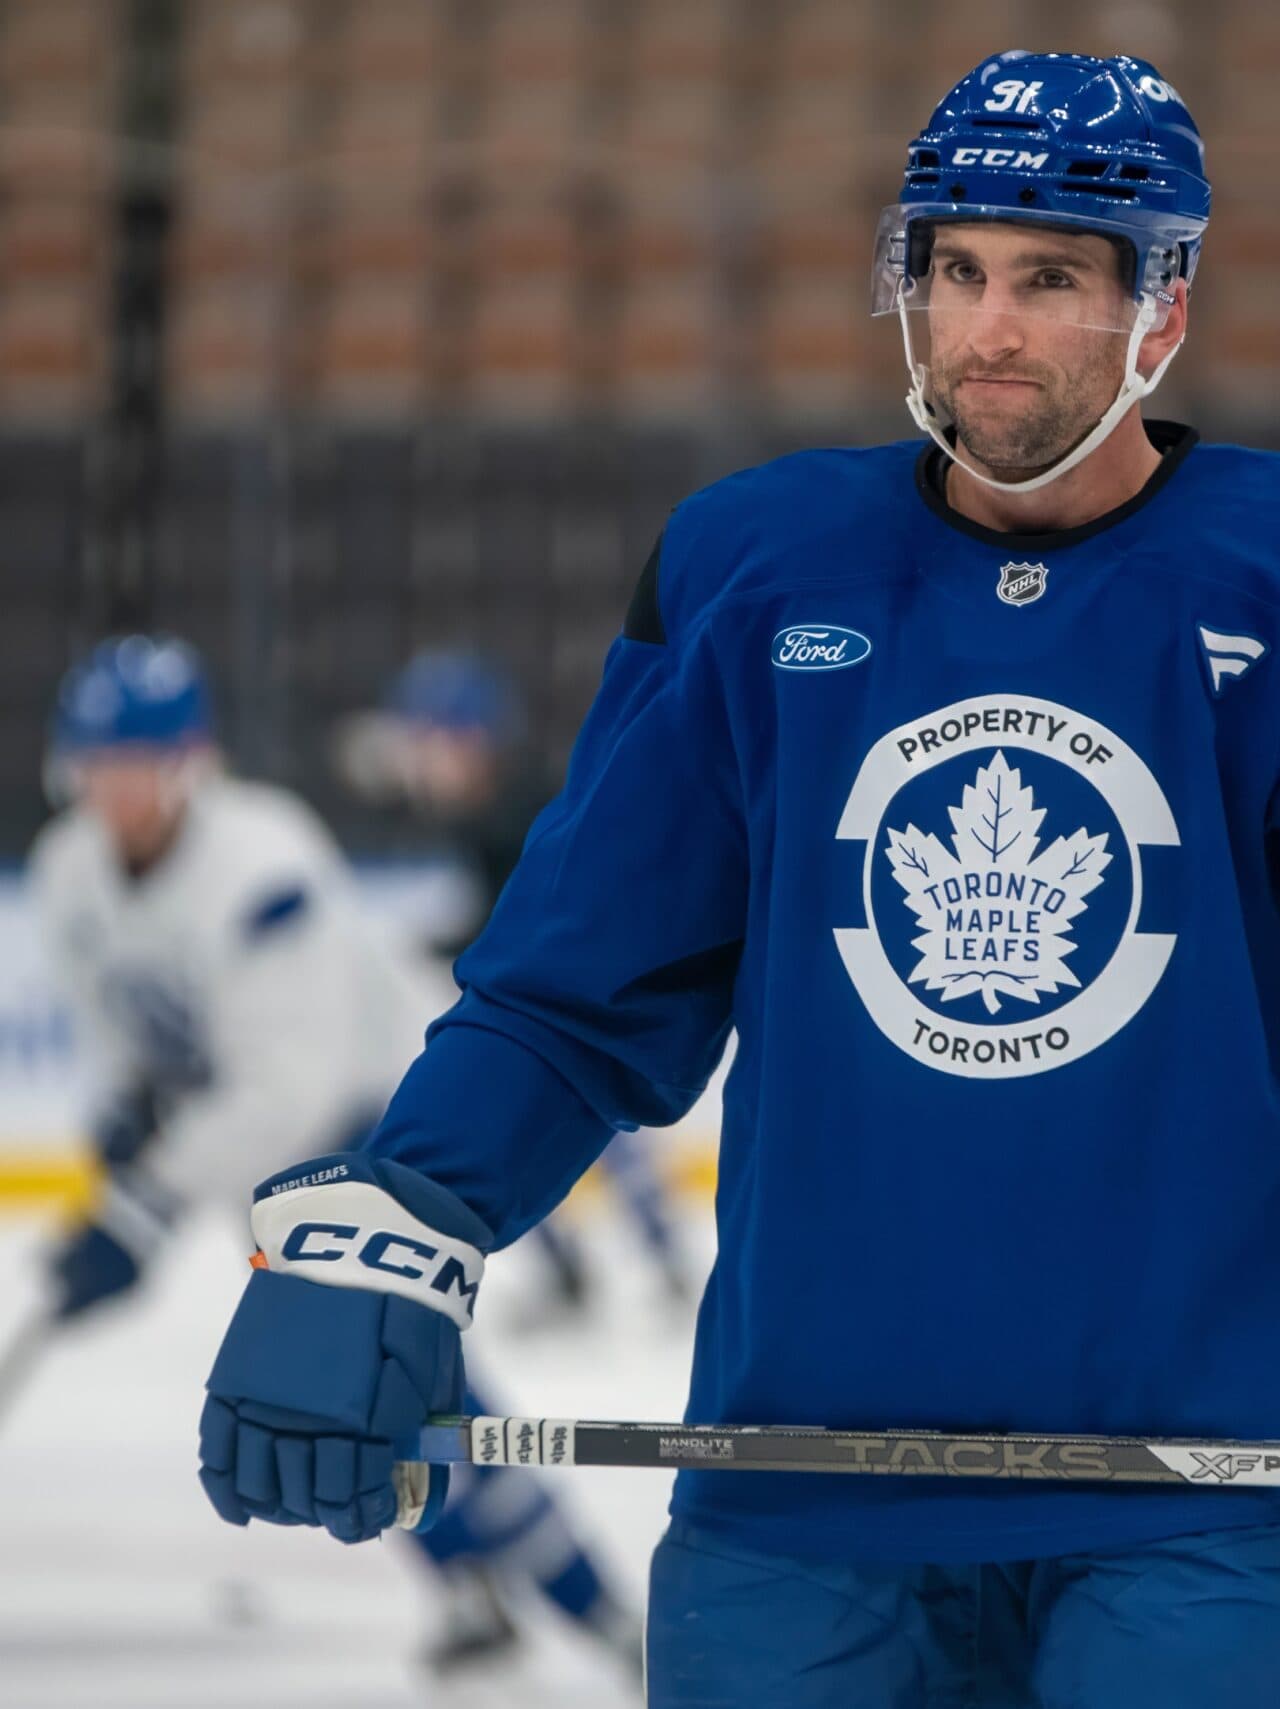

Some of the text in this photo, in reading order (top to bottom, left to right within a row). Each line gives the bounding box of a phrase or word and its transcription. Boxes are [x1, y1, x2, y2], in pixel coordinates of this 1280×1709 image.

[984, 80, 1044, 114] 91
[952, 148, 1049, 170] CCM
[1008, 575, 1038, 596] NHL
[779, 631, 848, 662] Ford
[897, 708, 1113, 767] PROPERTY OF
[924, 871, 1066, 915] TORONTO
[945, 908, 1041, 934] MAPLE
[944, 937, 1040, 962] LEAFS
[911, 1018, 1070, 1064] TORONTO
[312, 1165, 349, 1184] LEAFS
[281, 1222, 479, 1320] CCM
[659, 1438, 734, 1449] NANOLITE
[833, 1438, 1109, 1478] TACKS
[1189, 1452, 1262, 1480] XF
